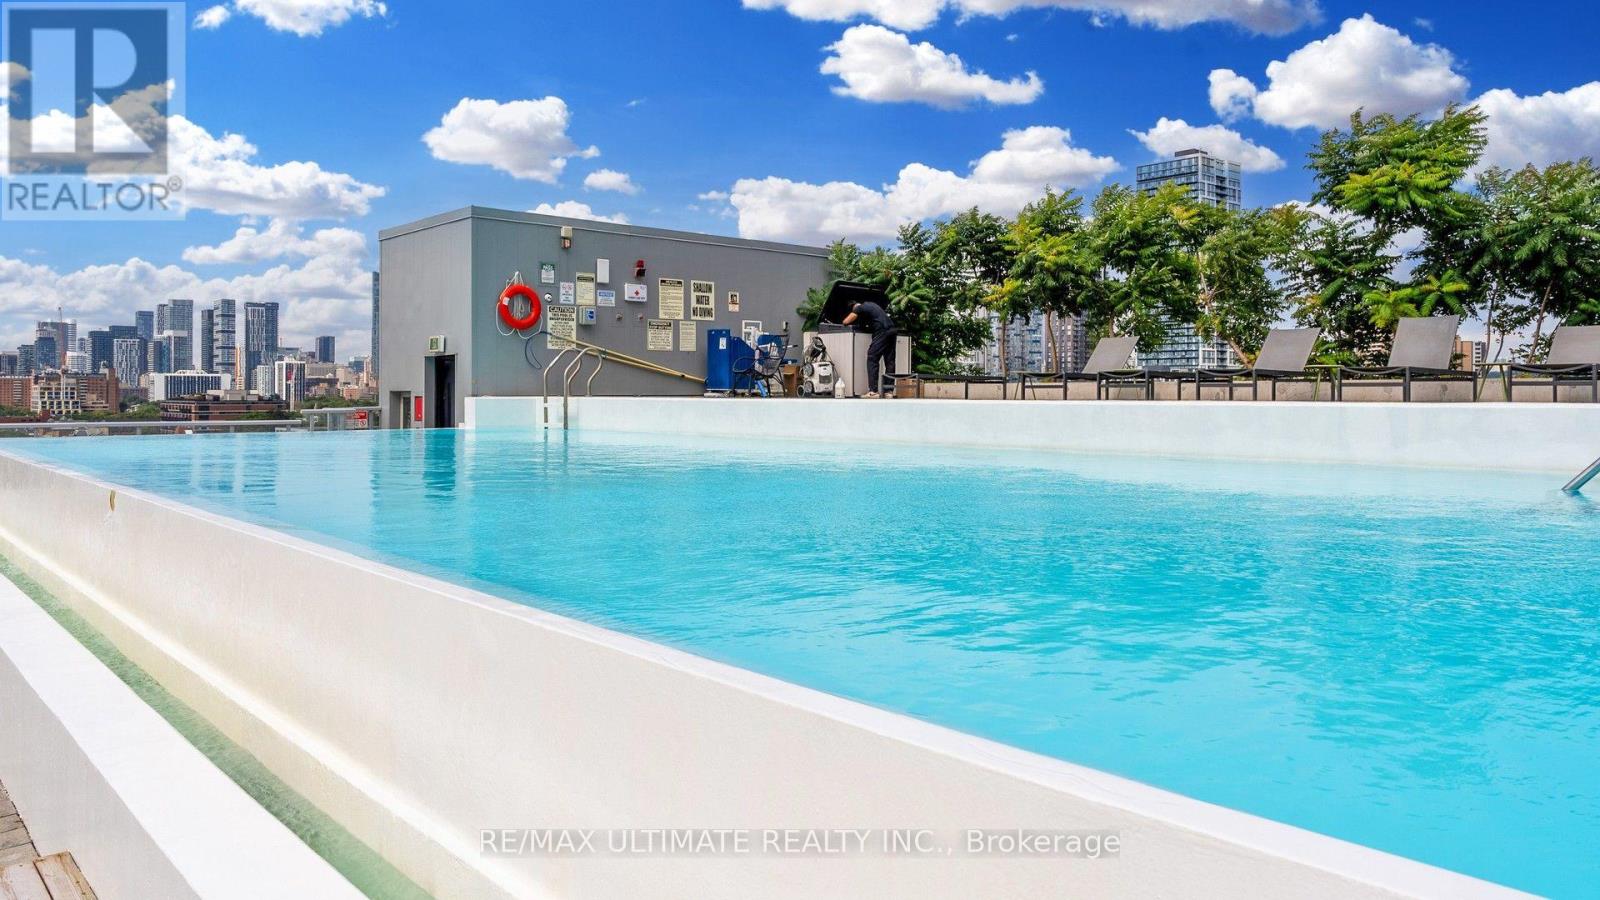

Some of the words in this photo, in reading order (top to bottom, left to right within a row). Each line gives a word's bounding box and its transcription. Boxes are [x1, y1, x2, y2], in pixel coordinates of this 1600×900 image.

[693, 282, 713, 294] SHALLOW
[695, 294, 710, 306] WATER
[549, 306, 576, 314] CAUTION
[692, 306, 698, 317] NO
[699, 307, 714, 318] DIVING
